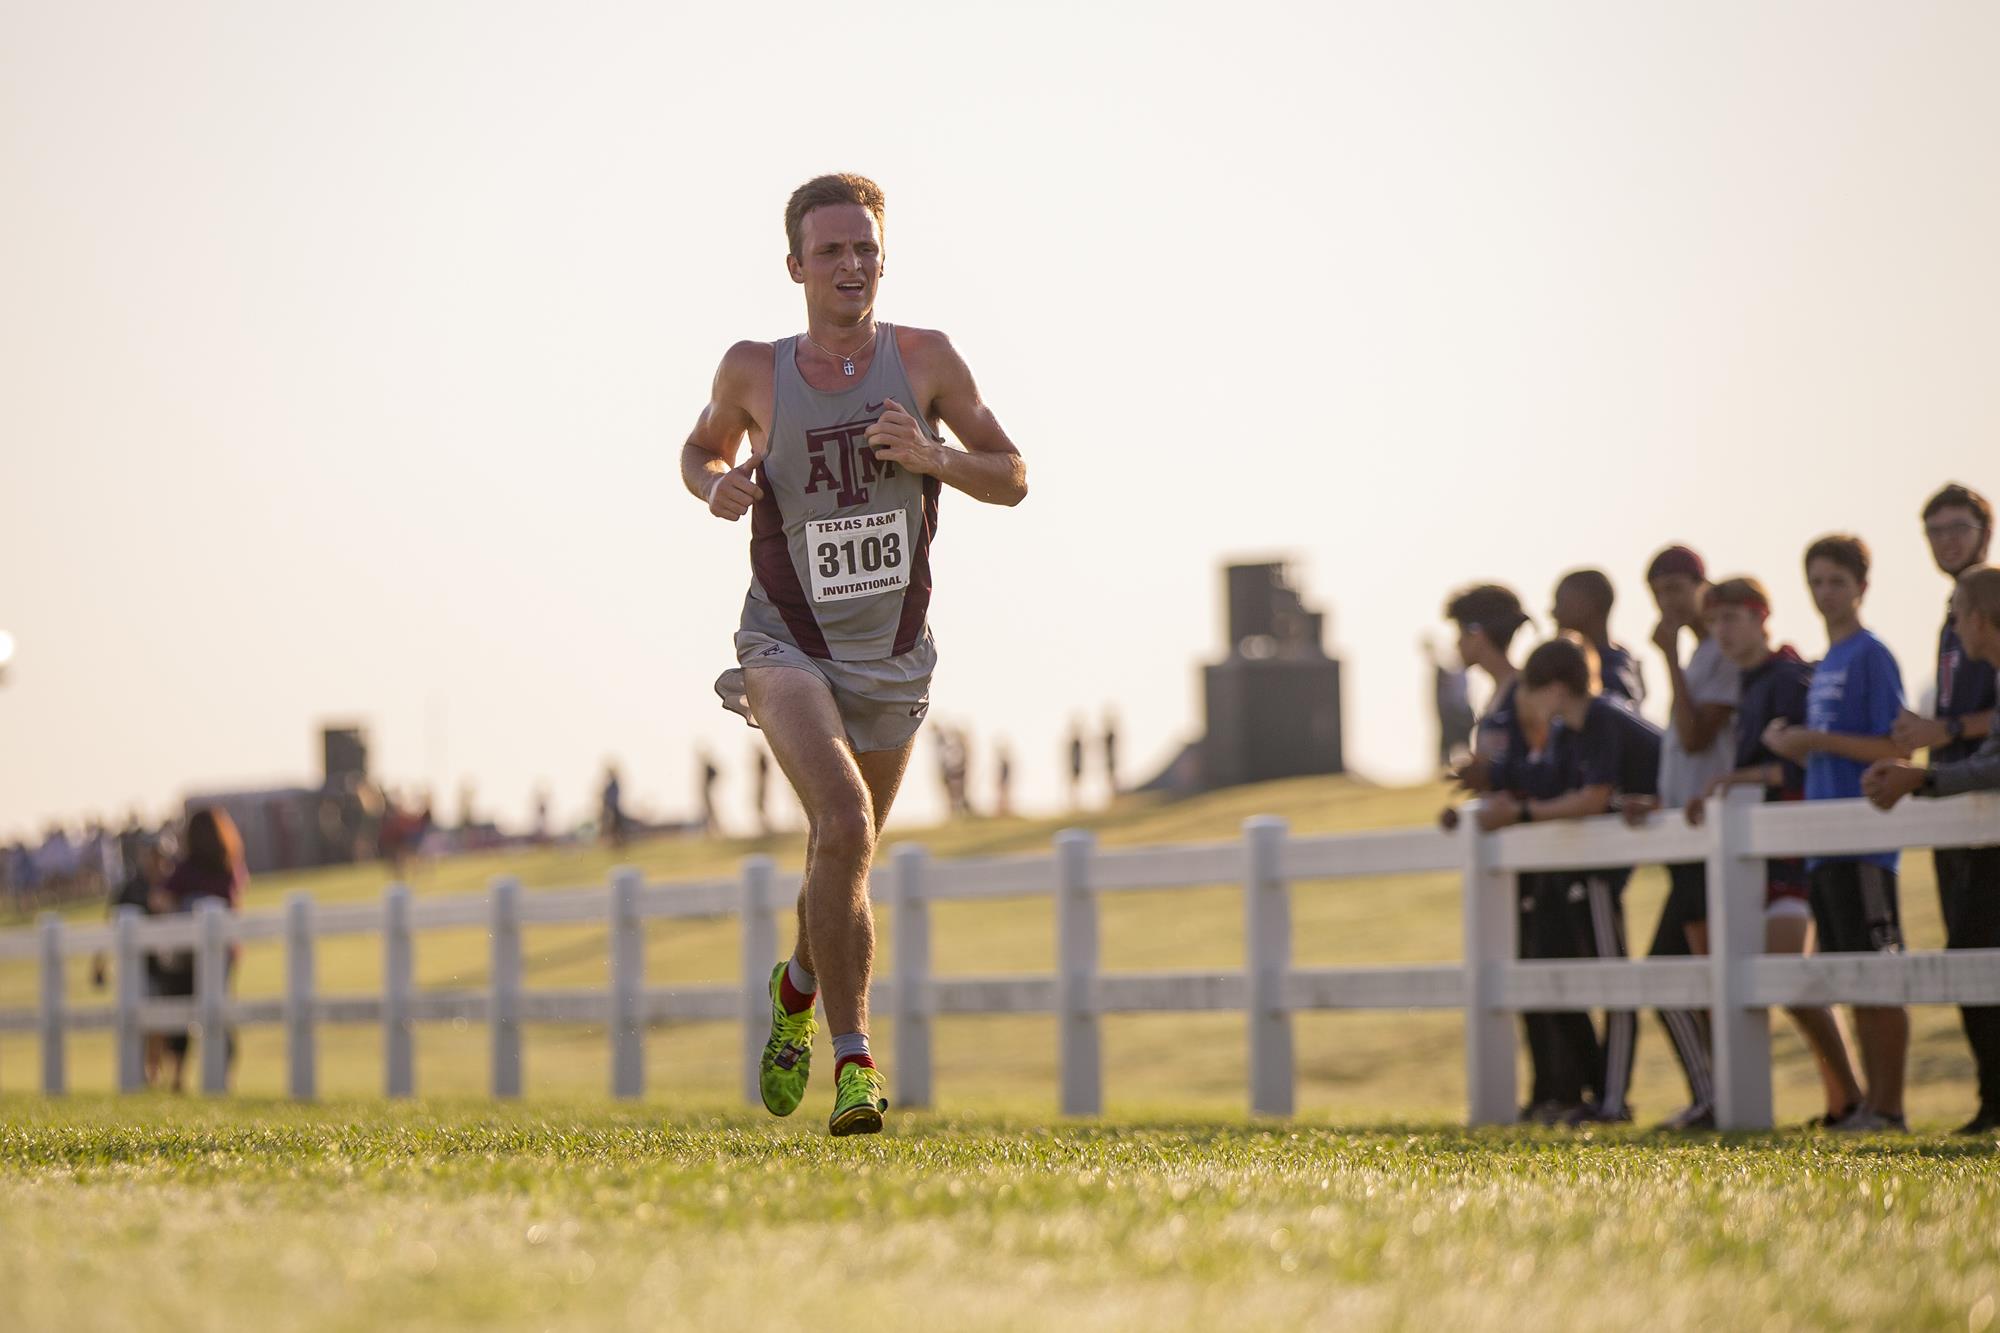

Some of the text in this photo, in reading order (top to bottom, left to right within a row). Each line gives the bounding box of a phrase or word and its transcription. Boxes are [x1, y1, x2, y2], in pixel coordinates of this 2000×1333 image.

[816, 513, 896, 533] TEXAS A&M
[817, 532, 902, 578] 3103
[823, 575, 902, 596] INVITATIONAL
